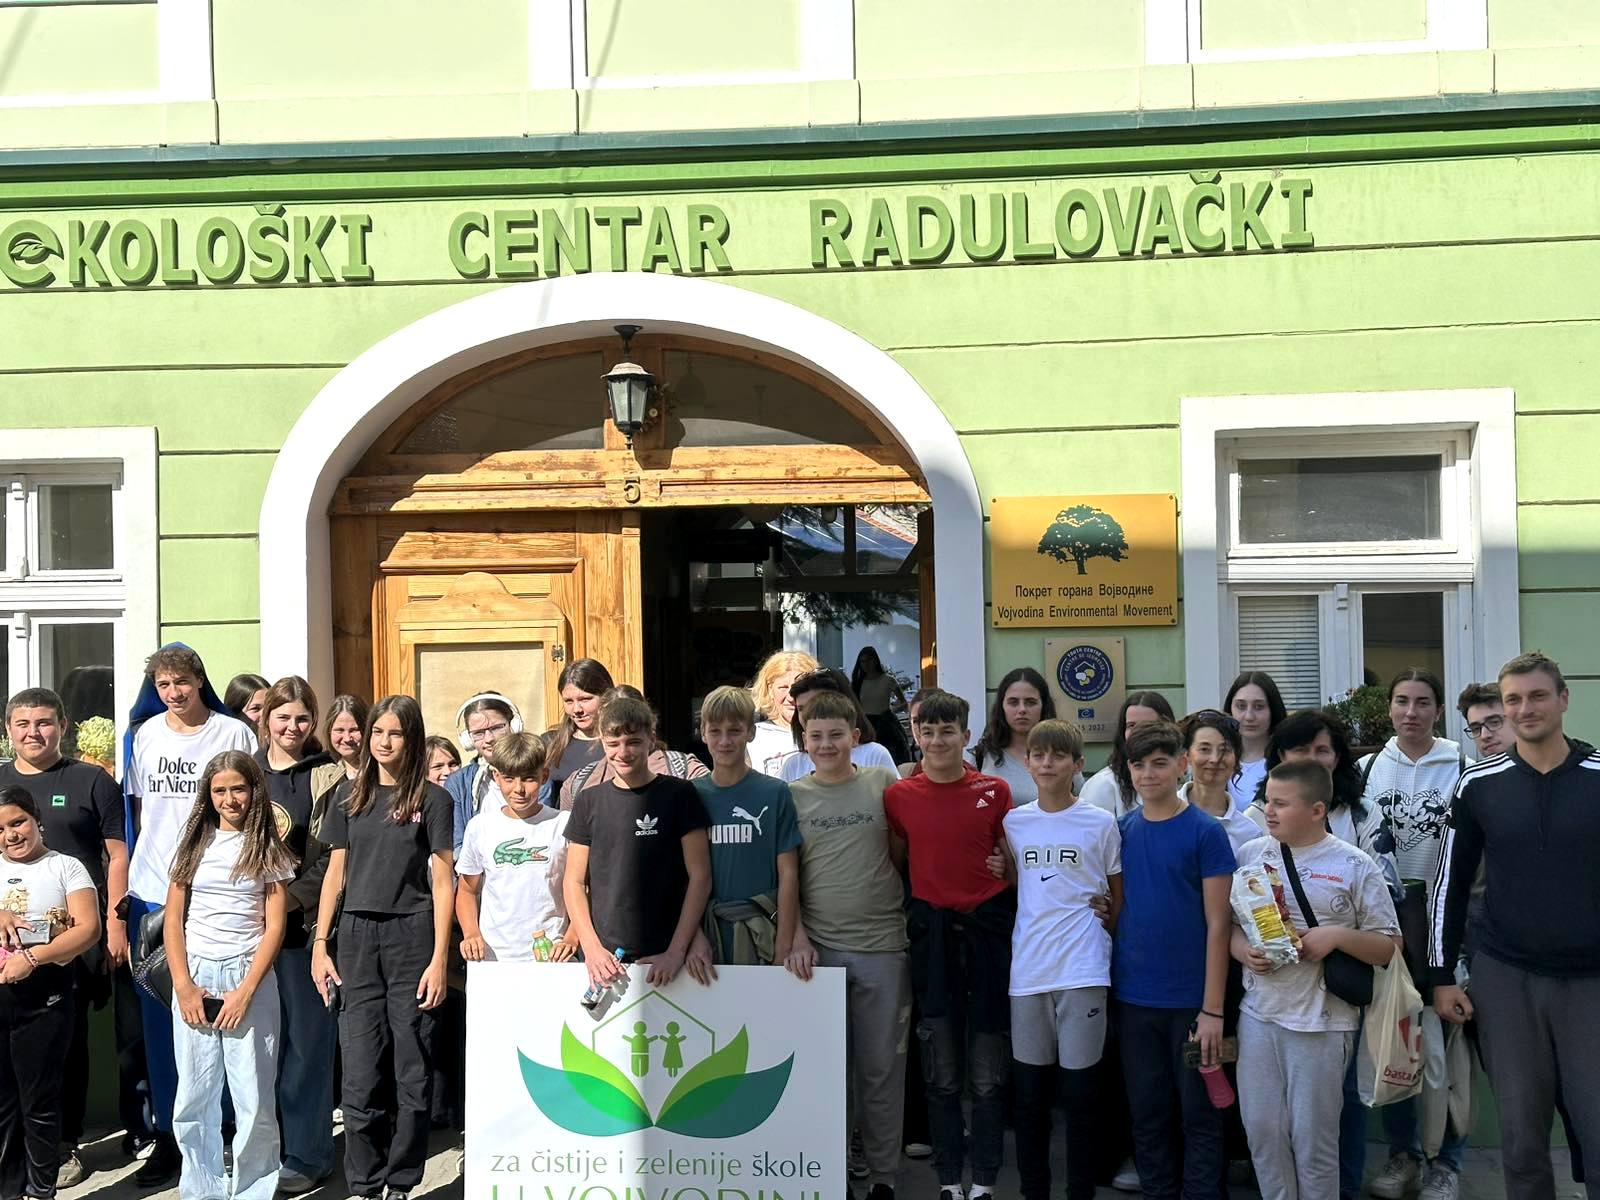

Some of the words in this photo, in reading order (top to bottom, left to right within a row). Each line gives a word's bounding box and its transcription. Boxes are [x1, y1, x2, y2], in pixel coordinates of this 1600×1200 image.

[448, 203, 733, 280] CENTAR
[809, 169, 1314, 270] RADULOVAČKI
[624, 477, 641, 504] 5
[1015, 585, 1052, 599] Покрет
[1058, 586, 1093, 600] горана
[1099, 583, 1154, 599] Војводине
[997, 605, 1044, 621] Vojvodina
[1050, 604, 1118, 618] Environmental
[1123, 603, 1173, 617] Movement
[158, 756, 197, 775] Dolce
[165, 775, 198, 793] Nien
[1024, 849, 1078, 864] AIR
[490, 1153, 520, 1173] za
[531, 1148, 608, 1184] čistije
[618, 1149, 624, 1174] i
[635, 1148, 742, 1185] zelenije
[752, 1150, 822, 1178] škole
